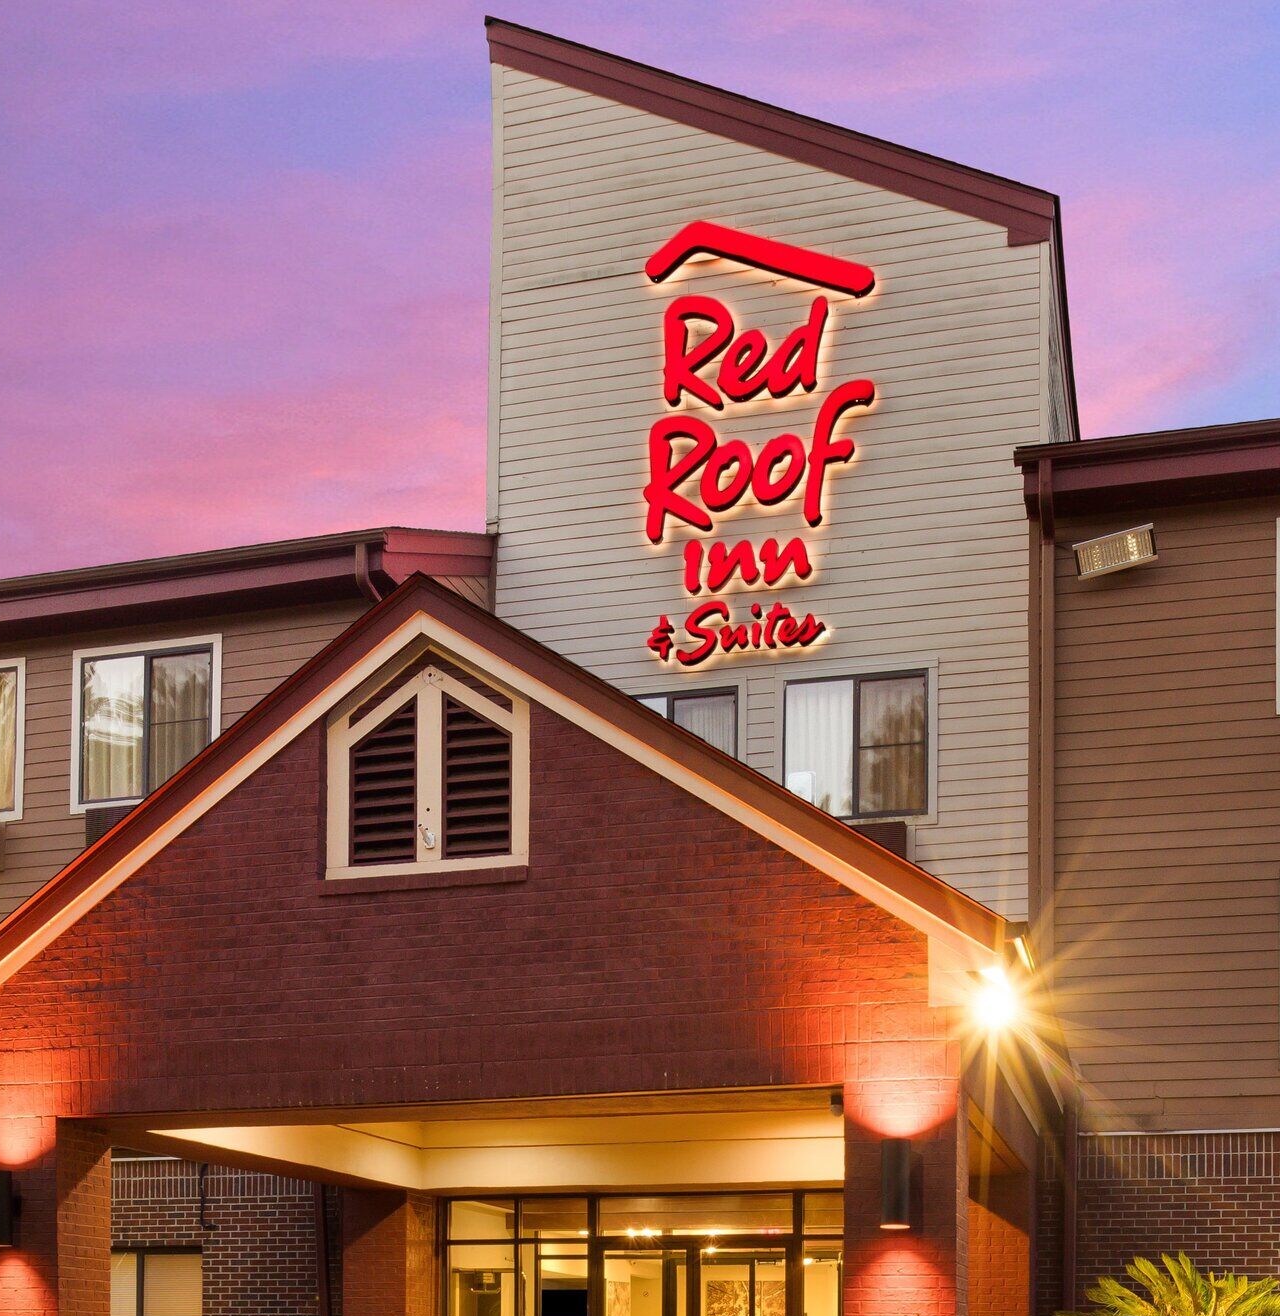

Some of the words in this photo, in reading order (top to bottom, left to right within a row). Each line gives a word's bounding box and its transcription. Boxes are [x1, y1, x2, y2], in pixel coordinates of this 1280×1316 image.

[663, 295, 828, 410] Red
[643, 380, 875, 545] Roof
[647, 615, 674, 662] &
[676, 601, 826, 667] Suites
